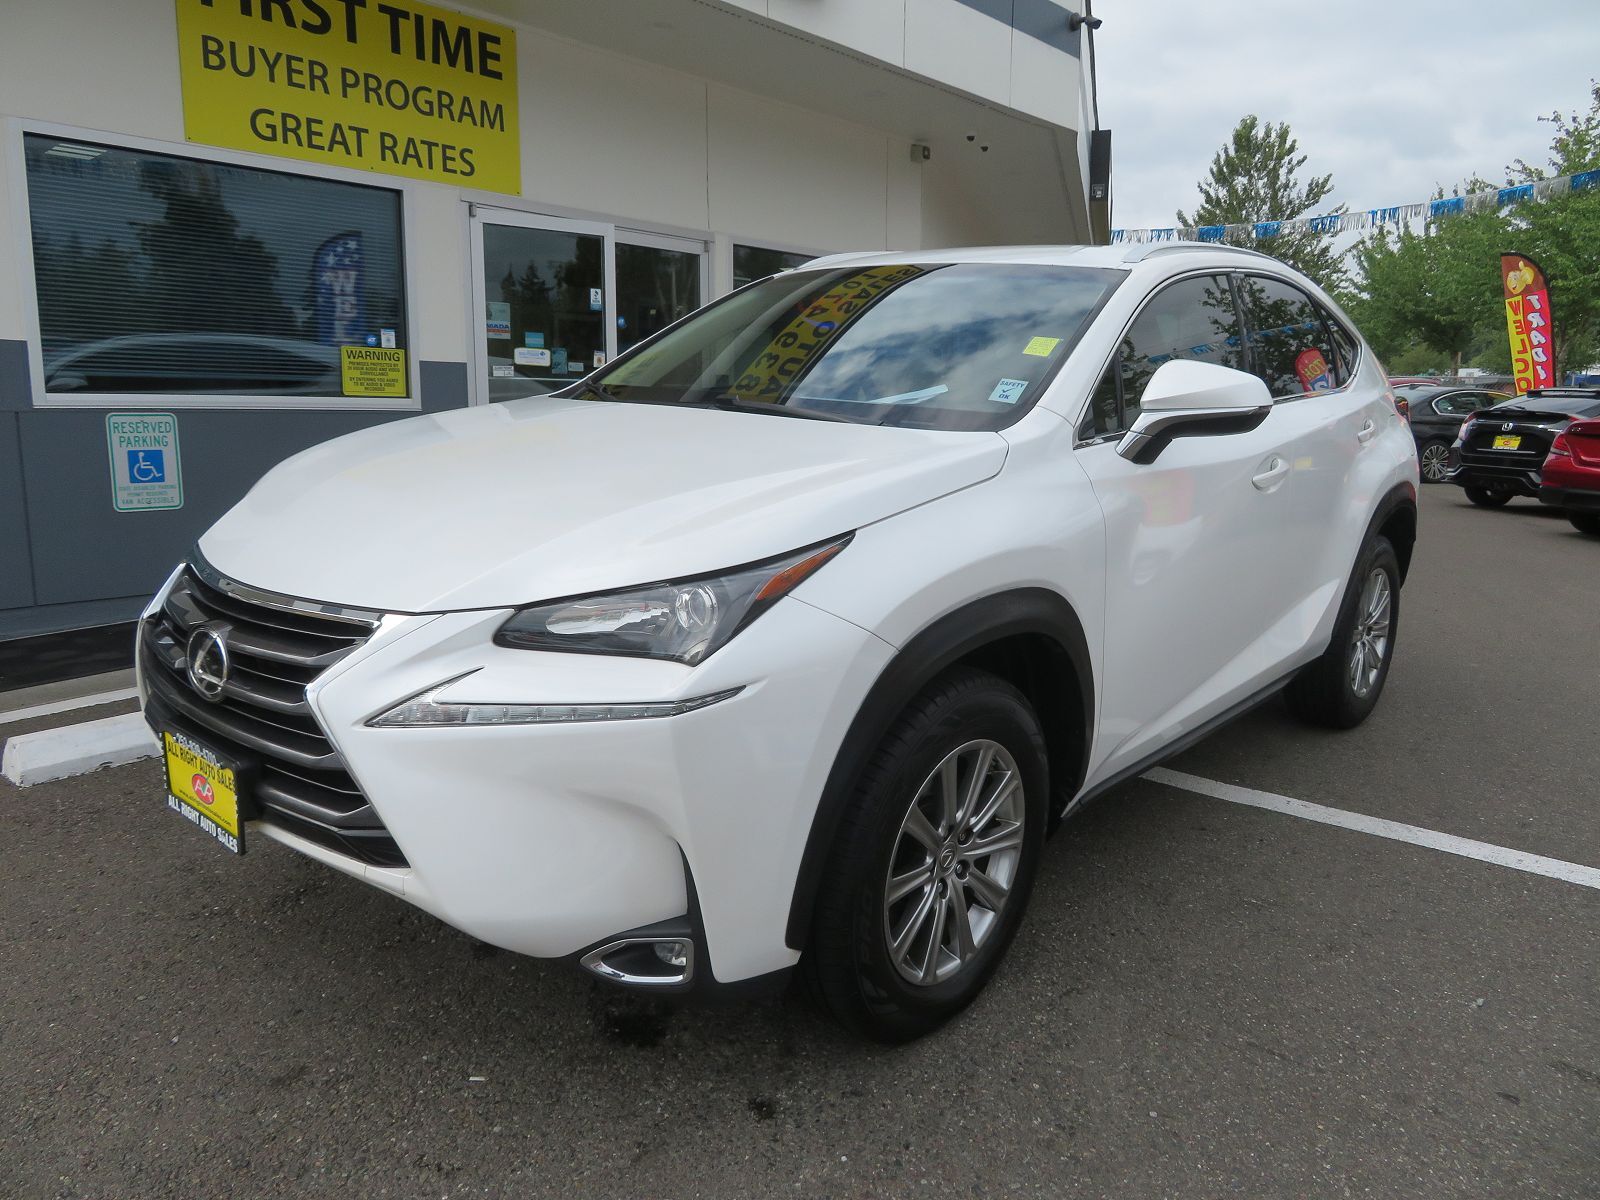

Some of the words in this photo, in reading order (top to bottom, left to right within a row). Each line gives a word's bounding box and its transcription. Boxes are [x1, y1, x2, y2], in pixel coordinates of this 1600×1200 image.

[378, 5, 504, 81] TIME
[201, 34, 330, 96] BUYER
[340, 66, 506, 133] PROGRAM
[250, 107, 369, 158] GREAT
[379, 130, 476, 178] RATES
[346, 349, 400, 362] WARNING
[1303, 358, 1326, 380] HOT
[1000, 380, 1025, 388] SAFETY
[112, 421, 172, 434] RESERVED
[119, 435, 169, 448] PARKING
[167, 741, 179, 758] ALL
[179, 747, 198, 769] RIGHT
[199, 759, 216, 781] AUTO
[168, 794, 180, 812] ALL
[180, 801, 200, 825] RIGHT
[200, 815, 217, 838] AUTO
[217, 827, 238, 854] SALES
